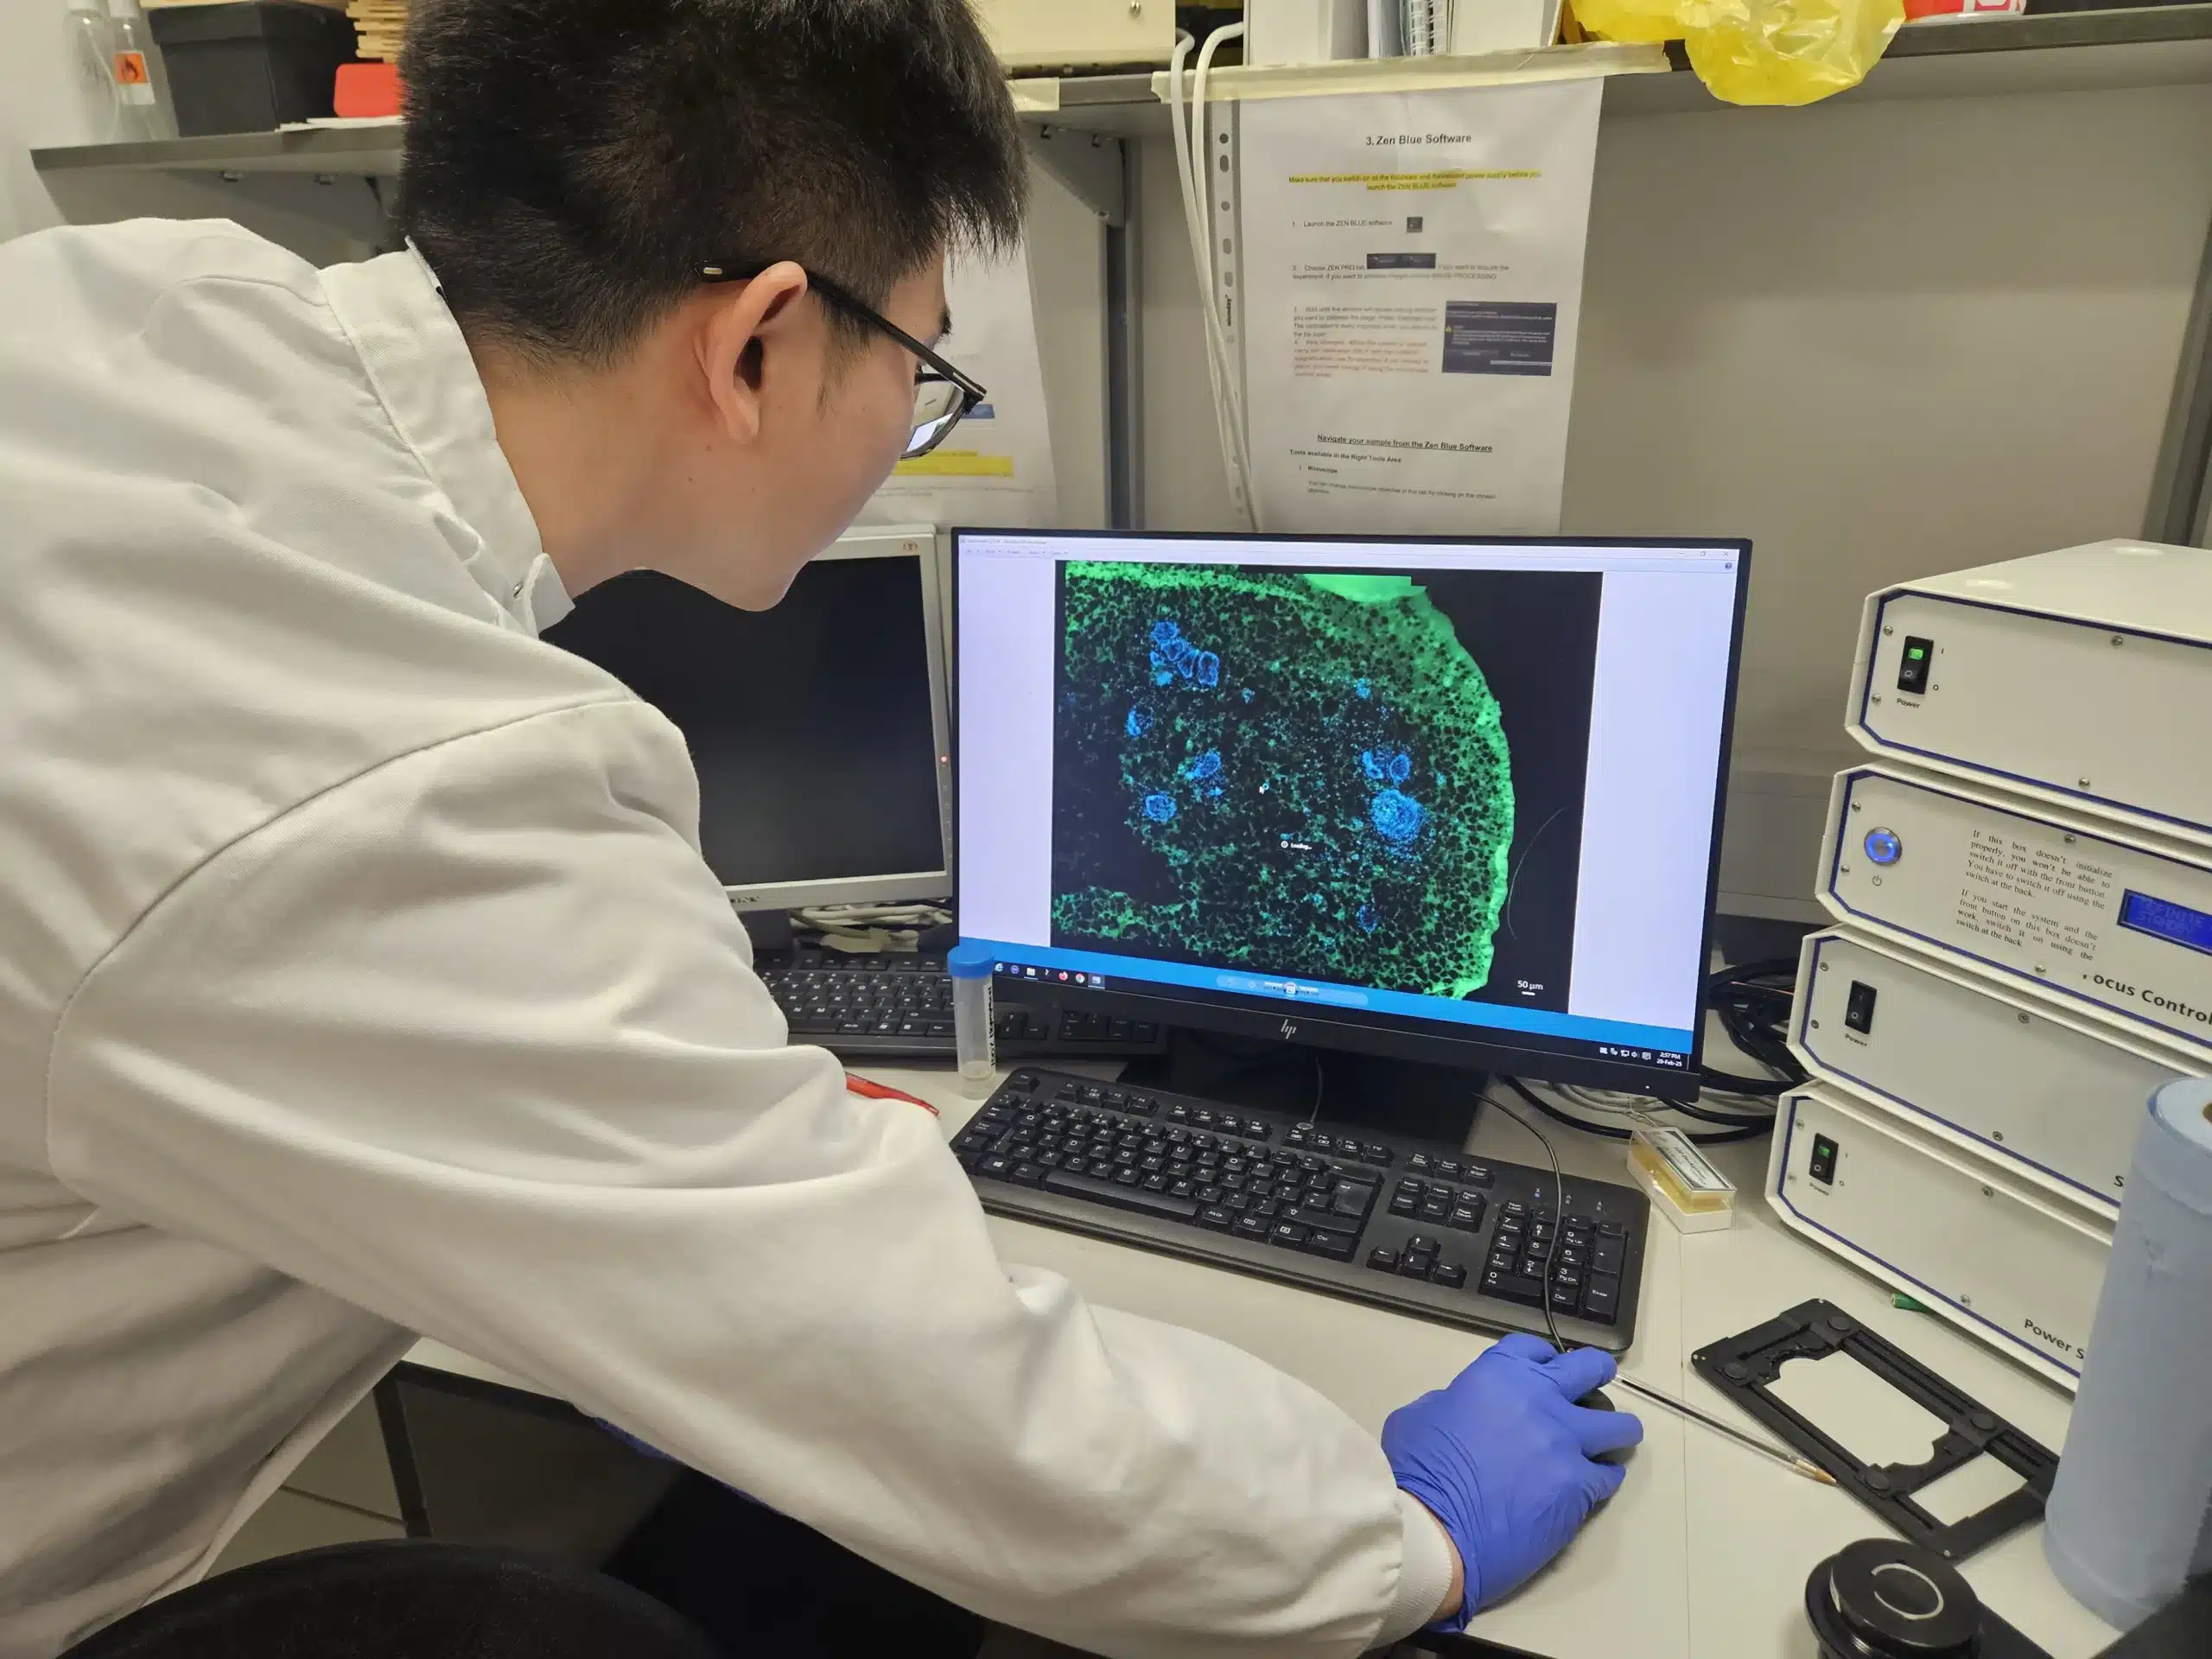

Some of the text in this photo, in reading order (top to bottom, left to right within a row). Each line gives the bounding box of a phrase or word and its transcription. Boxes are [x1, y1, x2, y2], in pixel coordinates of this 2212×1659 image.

[1376, 136, 1395, 145] Zen
[1400, 135, 1422, 144] Blue
[1426, 133, 1471, 143] Software
[1317, 434, 1346, 442] Navigate
[1459, 442, 1493, 451] Software
[1897, 698, 1920, 709] Power
[1974, 830, 2113, 878] If this box doesn't initialize
[1970, 851, 1994, 864] switch
[2020, 867, 2037, 877] with
[2041, 873, 2053, 882] the
[2055, 877, 2075, 889] front
[2078, 884, 2107, 899] button.
[2011, 854, 2026, 863] you
[2032, 860, 2055, 872] won't
[2062, 868, 2072, 876] be
[2077, 874, 2095, 884] able
[1965, 871, 1989, 884] switch
[2000, 881, 2012, 890] the
[2014, 885, 2036, 899] back.
[1968, 860, 1984, 871] You
[1986, 865, 2004, 878] have
[2016, 876, 2042, 890] switch
[2067, 893, 2089, 906] using
[2092, 899, 2105, 909] the
[1960, 899, 1977, 911] front
[1982, 906, 2006, 920] button
[2025, 921, 2040, 931] this
[2045, 927, 2060, 939] box
[2065, 935, 2096, 950] doesn't
[1961, 888, 2098, 940] If you start the system and the
[1956, 919, 1980, 932] switch
[1990, 930, 2003, 940] the
[2005, 935, 2022, 947] back
[1958, 909, 1979, 923] work,
[1986, 918, 2012, 933] switch
[2050, 942, 2073, 956] using
[2080, 951, 2094, 961] the
[1517, 980, 1529, 988] 50
[1281, 1020, 1297, 1039] hp
[1845, 1033, 1867, 1047] Power
[2024, 1319, 2073, 1352] Power
